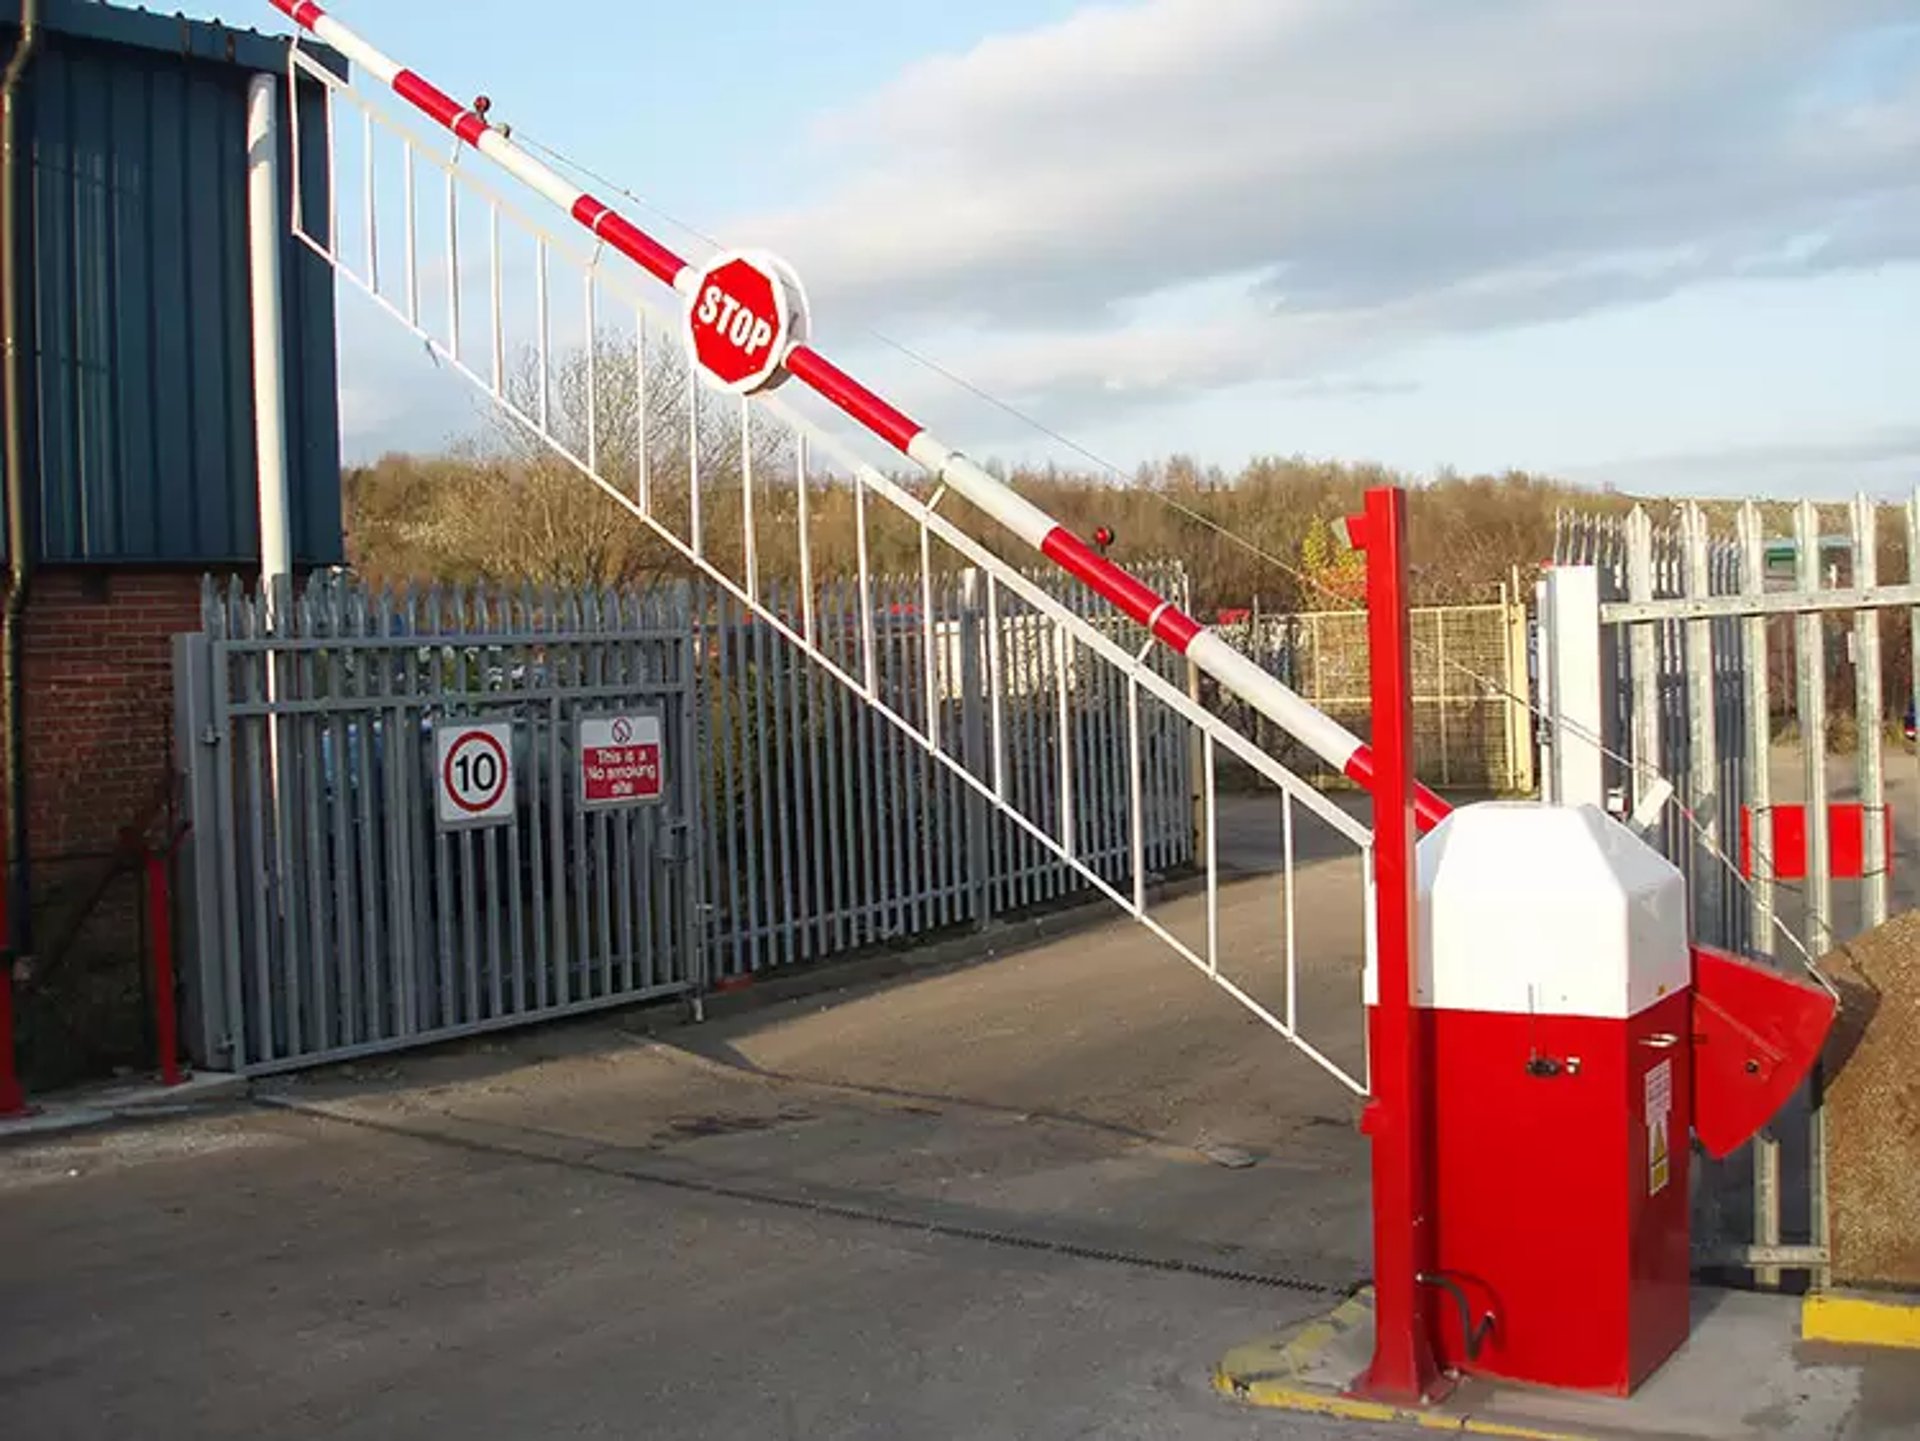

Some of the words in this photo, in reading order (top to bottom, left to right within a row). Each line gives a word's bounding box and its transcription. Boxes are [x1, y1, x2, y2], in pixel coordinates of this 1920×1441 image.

[698, 285, 771, 355] STOP
[597, 750, 621, 763] This
[625, 750, 634, 762] is
[455, 752, 497, 792] 10
[587, 767, 604, 779] No
